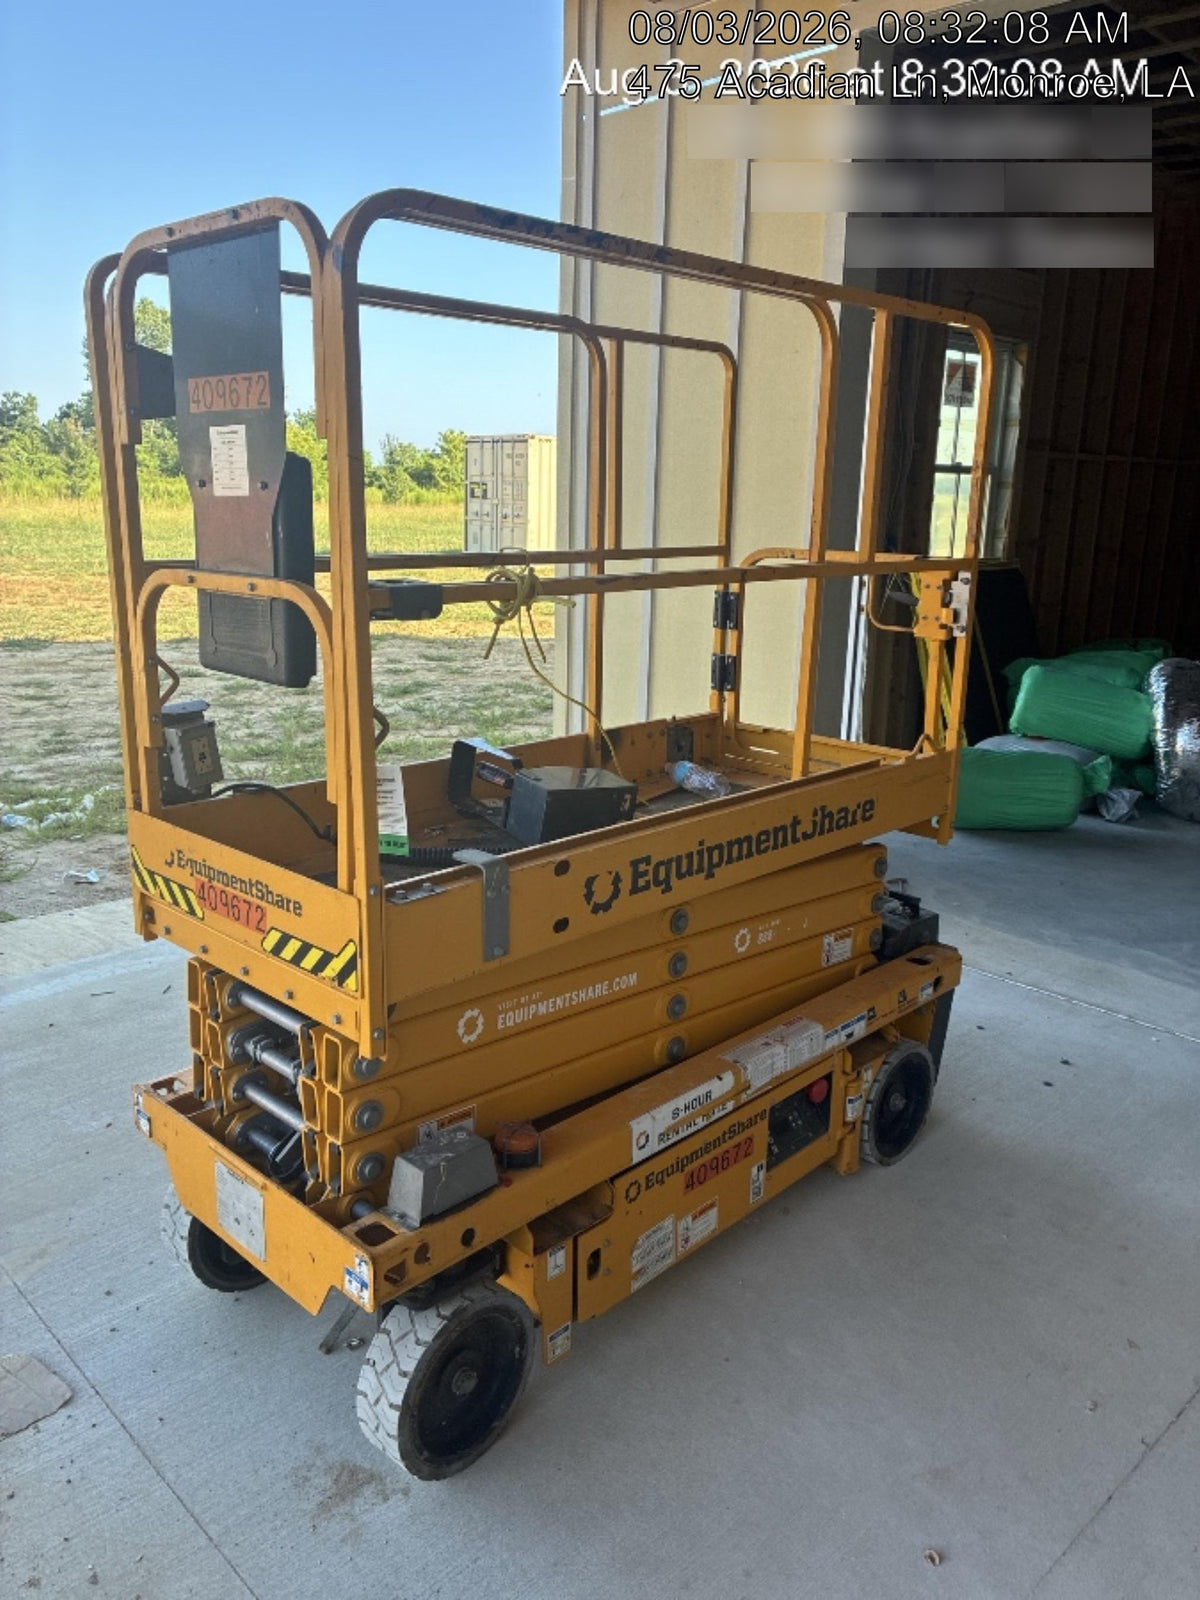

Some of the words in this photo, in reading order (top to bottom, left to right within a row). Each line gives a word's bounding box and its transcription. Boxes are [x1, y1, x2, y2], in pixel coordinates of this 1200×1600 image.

[191, 375, 268, 410] 409672
[176, 849, 303, 917] EquipmentShare
[196, 882, 266, 934] 409672
[497, 972, 638, 1030] EQUIPMENTSHARE.COM
[644, 1107, 767, 1191] EquipmentShare
[685, 1136, 753, 1192] 409672
